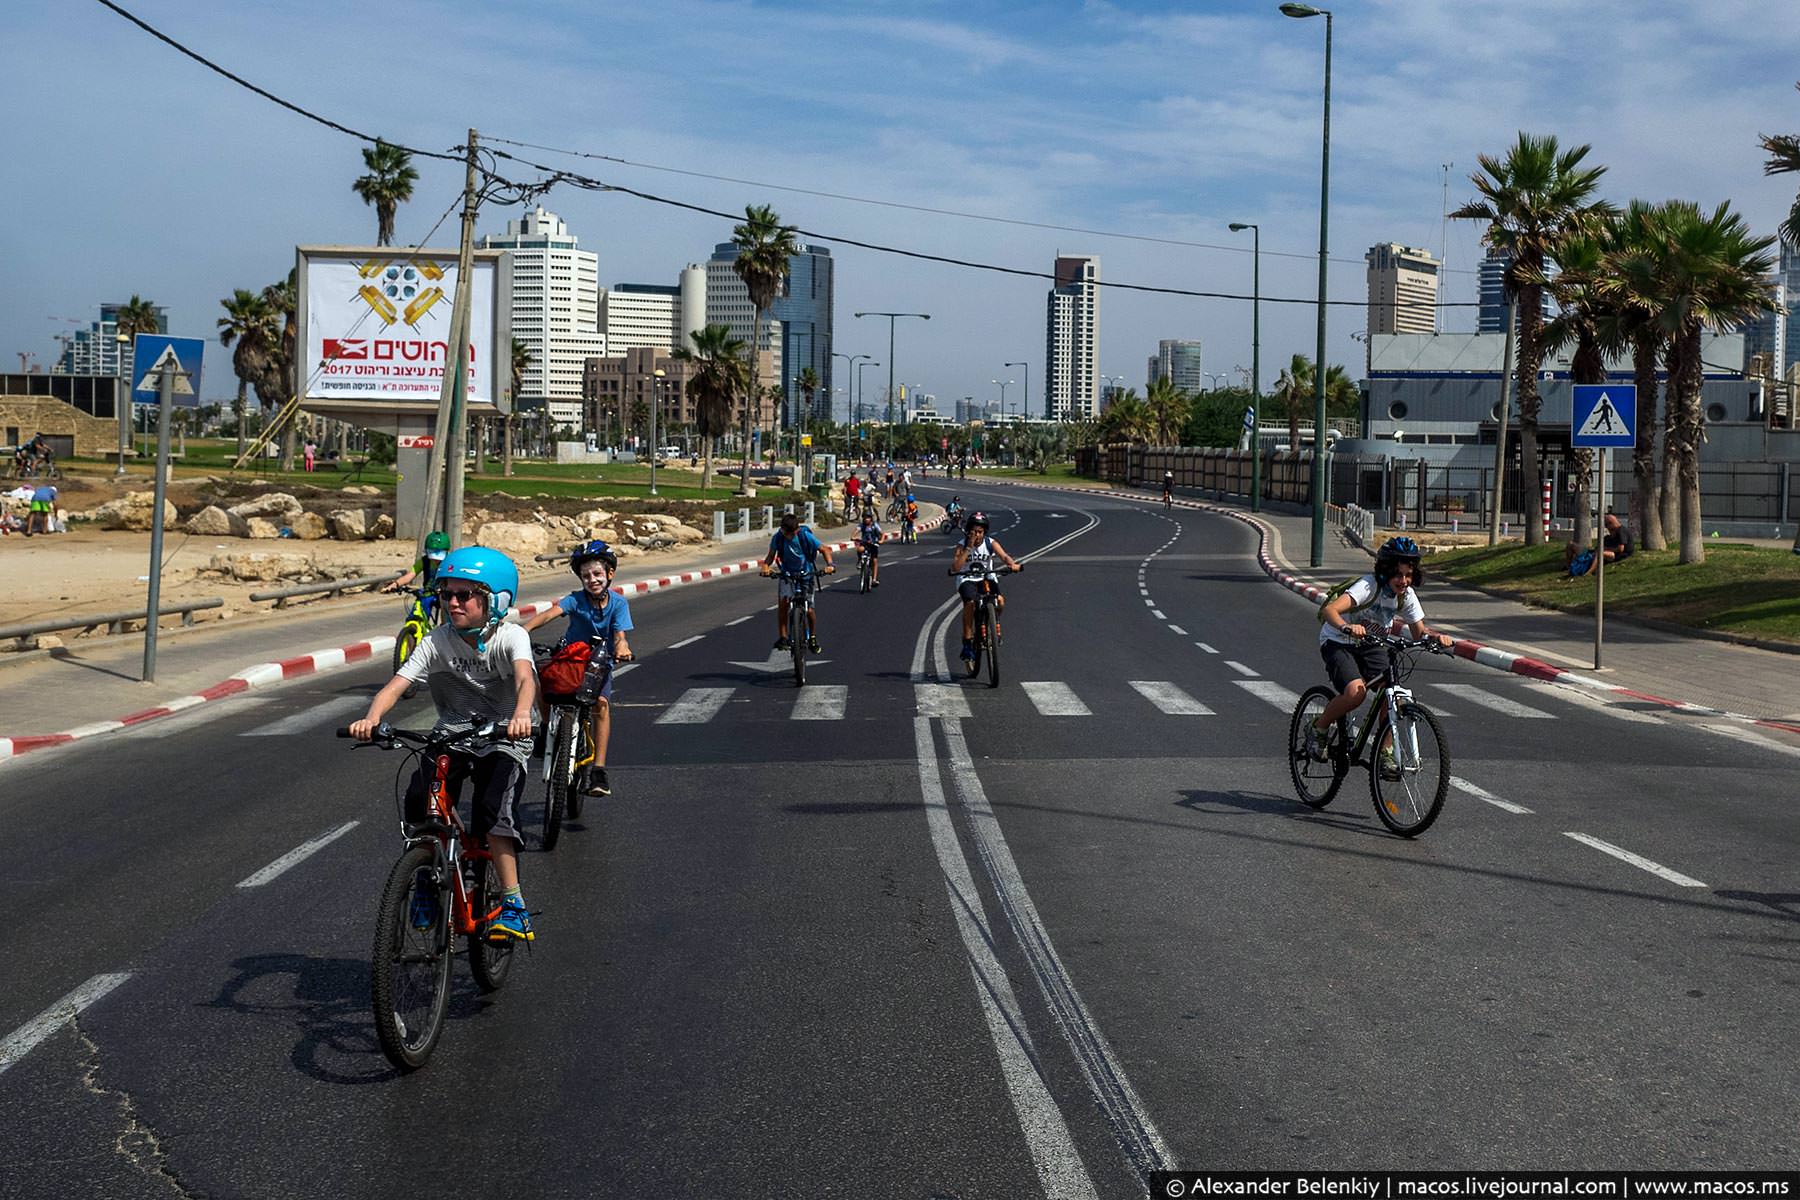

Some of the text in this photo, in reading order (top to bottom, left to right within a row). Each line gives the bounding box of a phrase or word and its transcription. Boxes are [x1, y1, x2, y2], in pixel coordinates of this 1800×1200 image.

[324, 364, 352, 375] 2017
[355, 365, 390, 376] וריהוט
[393, 366, 425, 377] עיצוב
